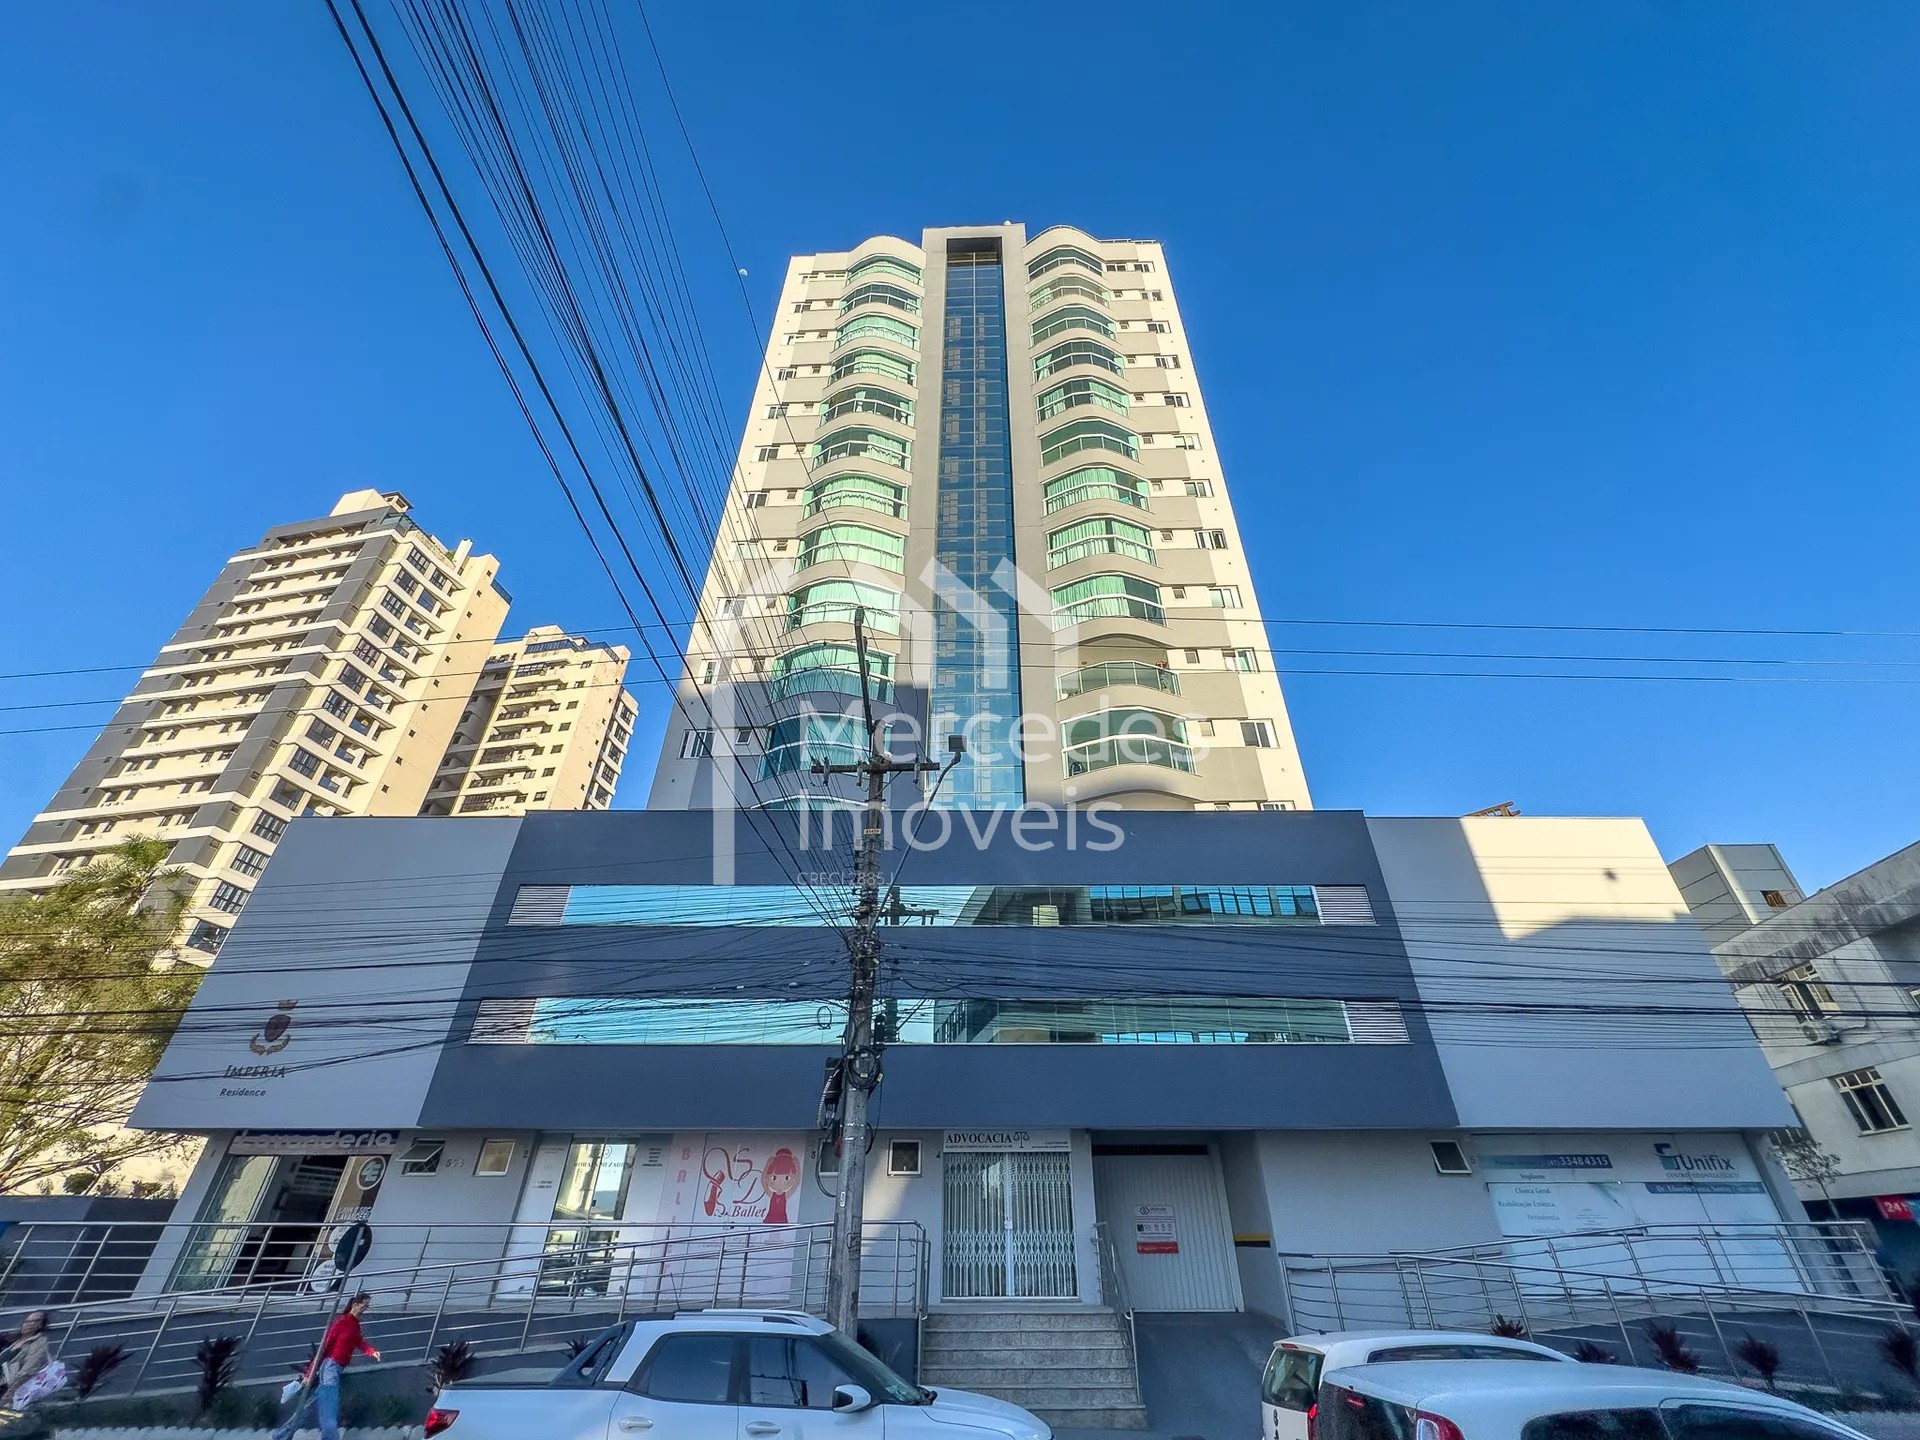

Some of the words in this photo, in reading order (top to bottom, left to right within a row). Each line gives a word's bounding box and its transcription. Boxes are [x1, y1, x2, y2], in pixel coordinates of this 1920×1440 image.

[219, 1088, 266, 1097] Residence
[238, 1129, 392, 1149] Lavanderia
[945, 1133, 1012, 1144] ADVOCACIA
[1679, 1153, 1736, 1171] Unifix
[732, 1206, 767, 1218] Ballet
